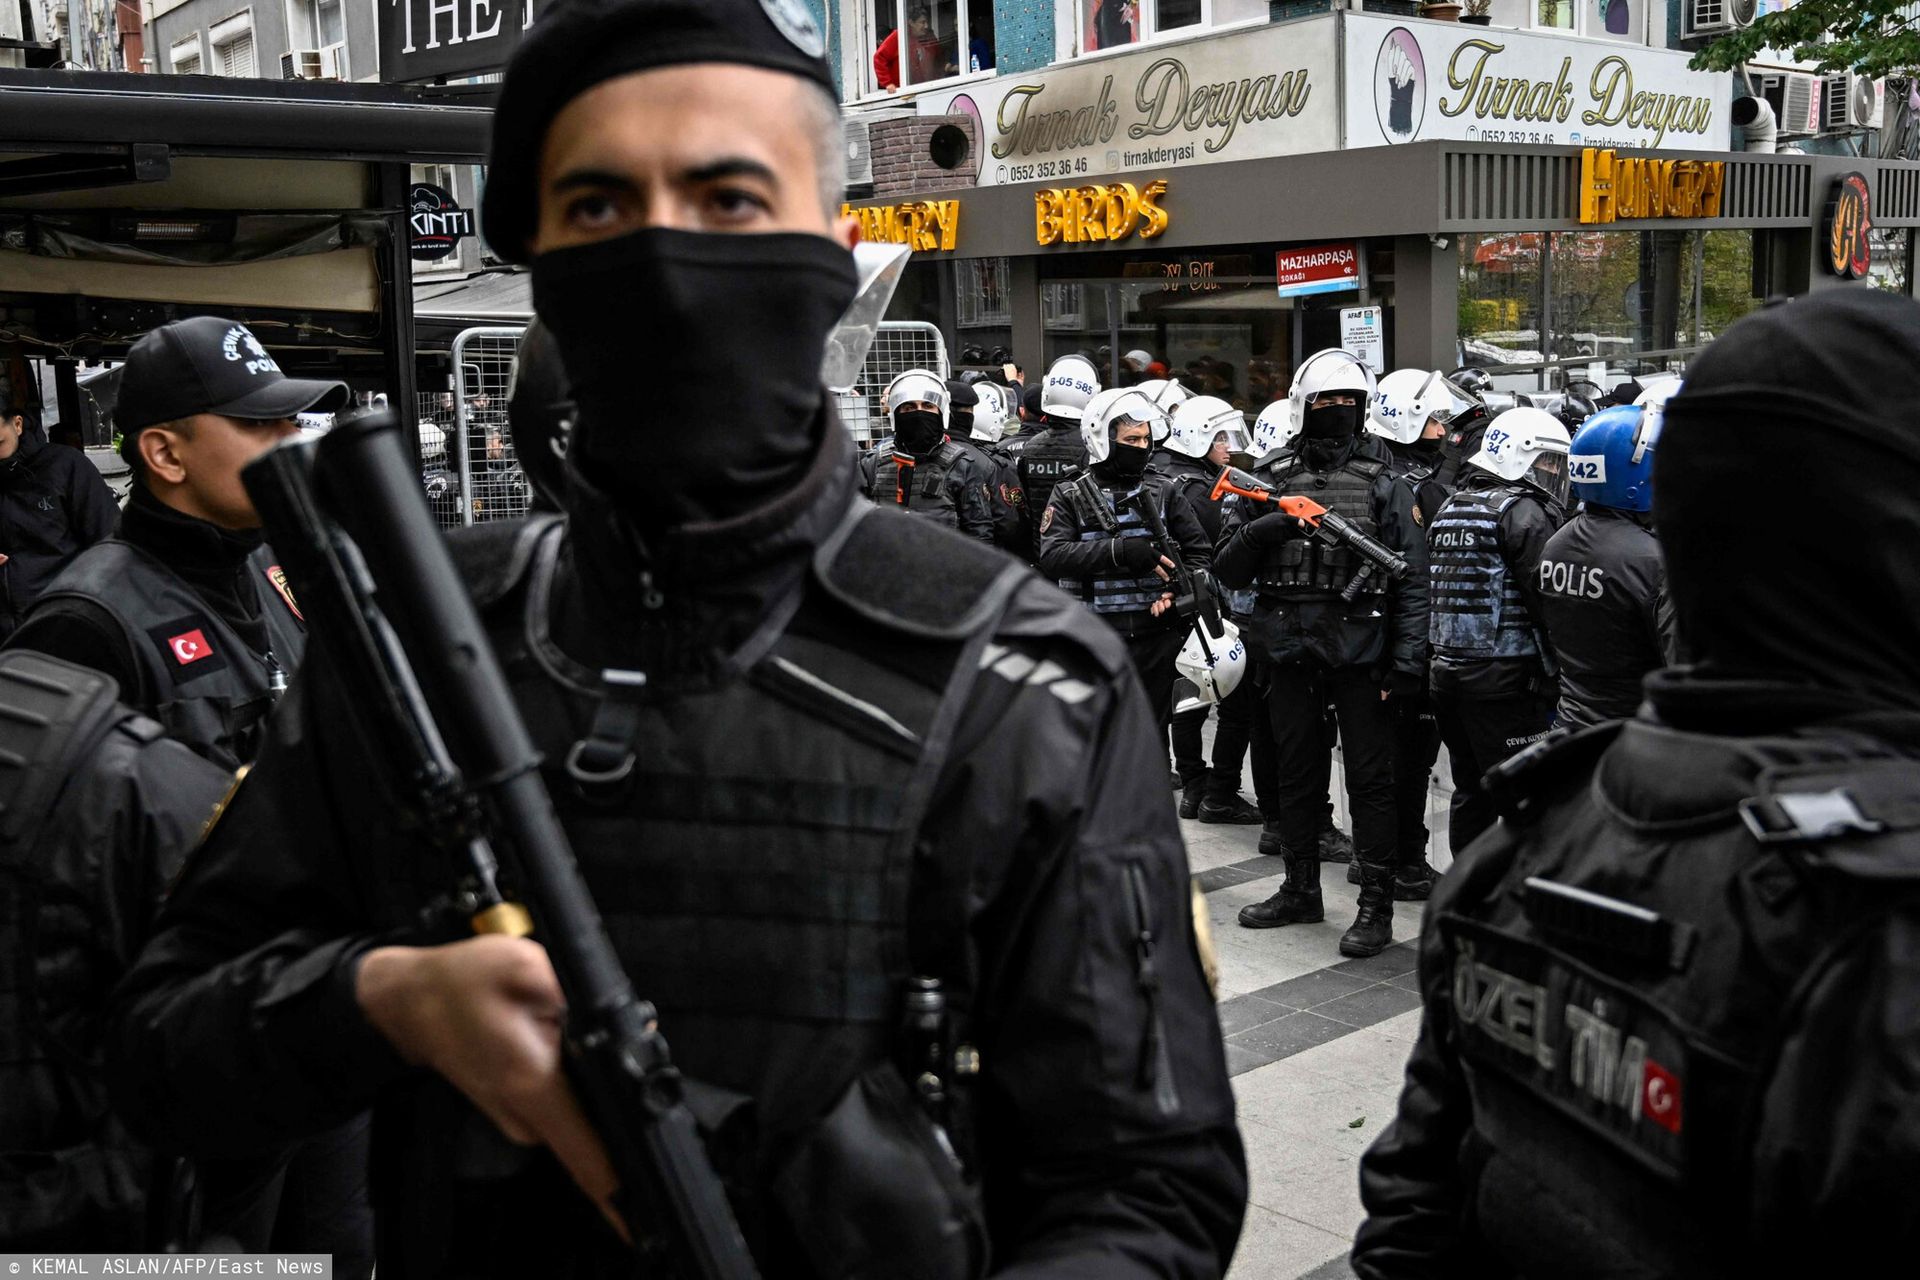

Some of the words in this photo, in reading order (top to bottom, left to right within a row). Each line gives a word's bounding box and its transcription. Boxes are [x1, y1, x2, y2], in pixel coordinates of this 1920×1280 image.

[1481, 130, 1506, 143] 0552
[1508, 131, 1526, 144] 352
[1529, 132, 1540, 144] 36
[1543, 133, 1554, 145] 46
[1124, 142, 1195, 167] tirnakderyasi
[1010, 164, 1034, 181] 0552
[1037, 161, 1055, 178] 352
[1059, 159, 1071, 175] 36
[1074, 157, 1088, 172] 46
[1580, 148, 1725, 224] HUNGRY
[1036, 180, 1169, 246] BIRDS
[1280, 249, 1354, 271] MAZHARPAŞA
[1280, 273, 1306, 283] SOKAĞI
[1075, 381, 1093, 396] 585
[1382, 407, 1397, 417] 34
[1172, 428, 1181, 437] 34
[1257, 438, 1267, 450] 34
[1487, 442, 1500, 454] 34
[1569, 462, 1598, 478] 242
[1435, 529, 1475, 547] POLİS
[1540, 560, 1604, 599] POLİS
